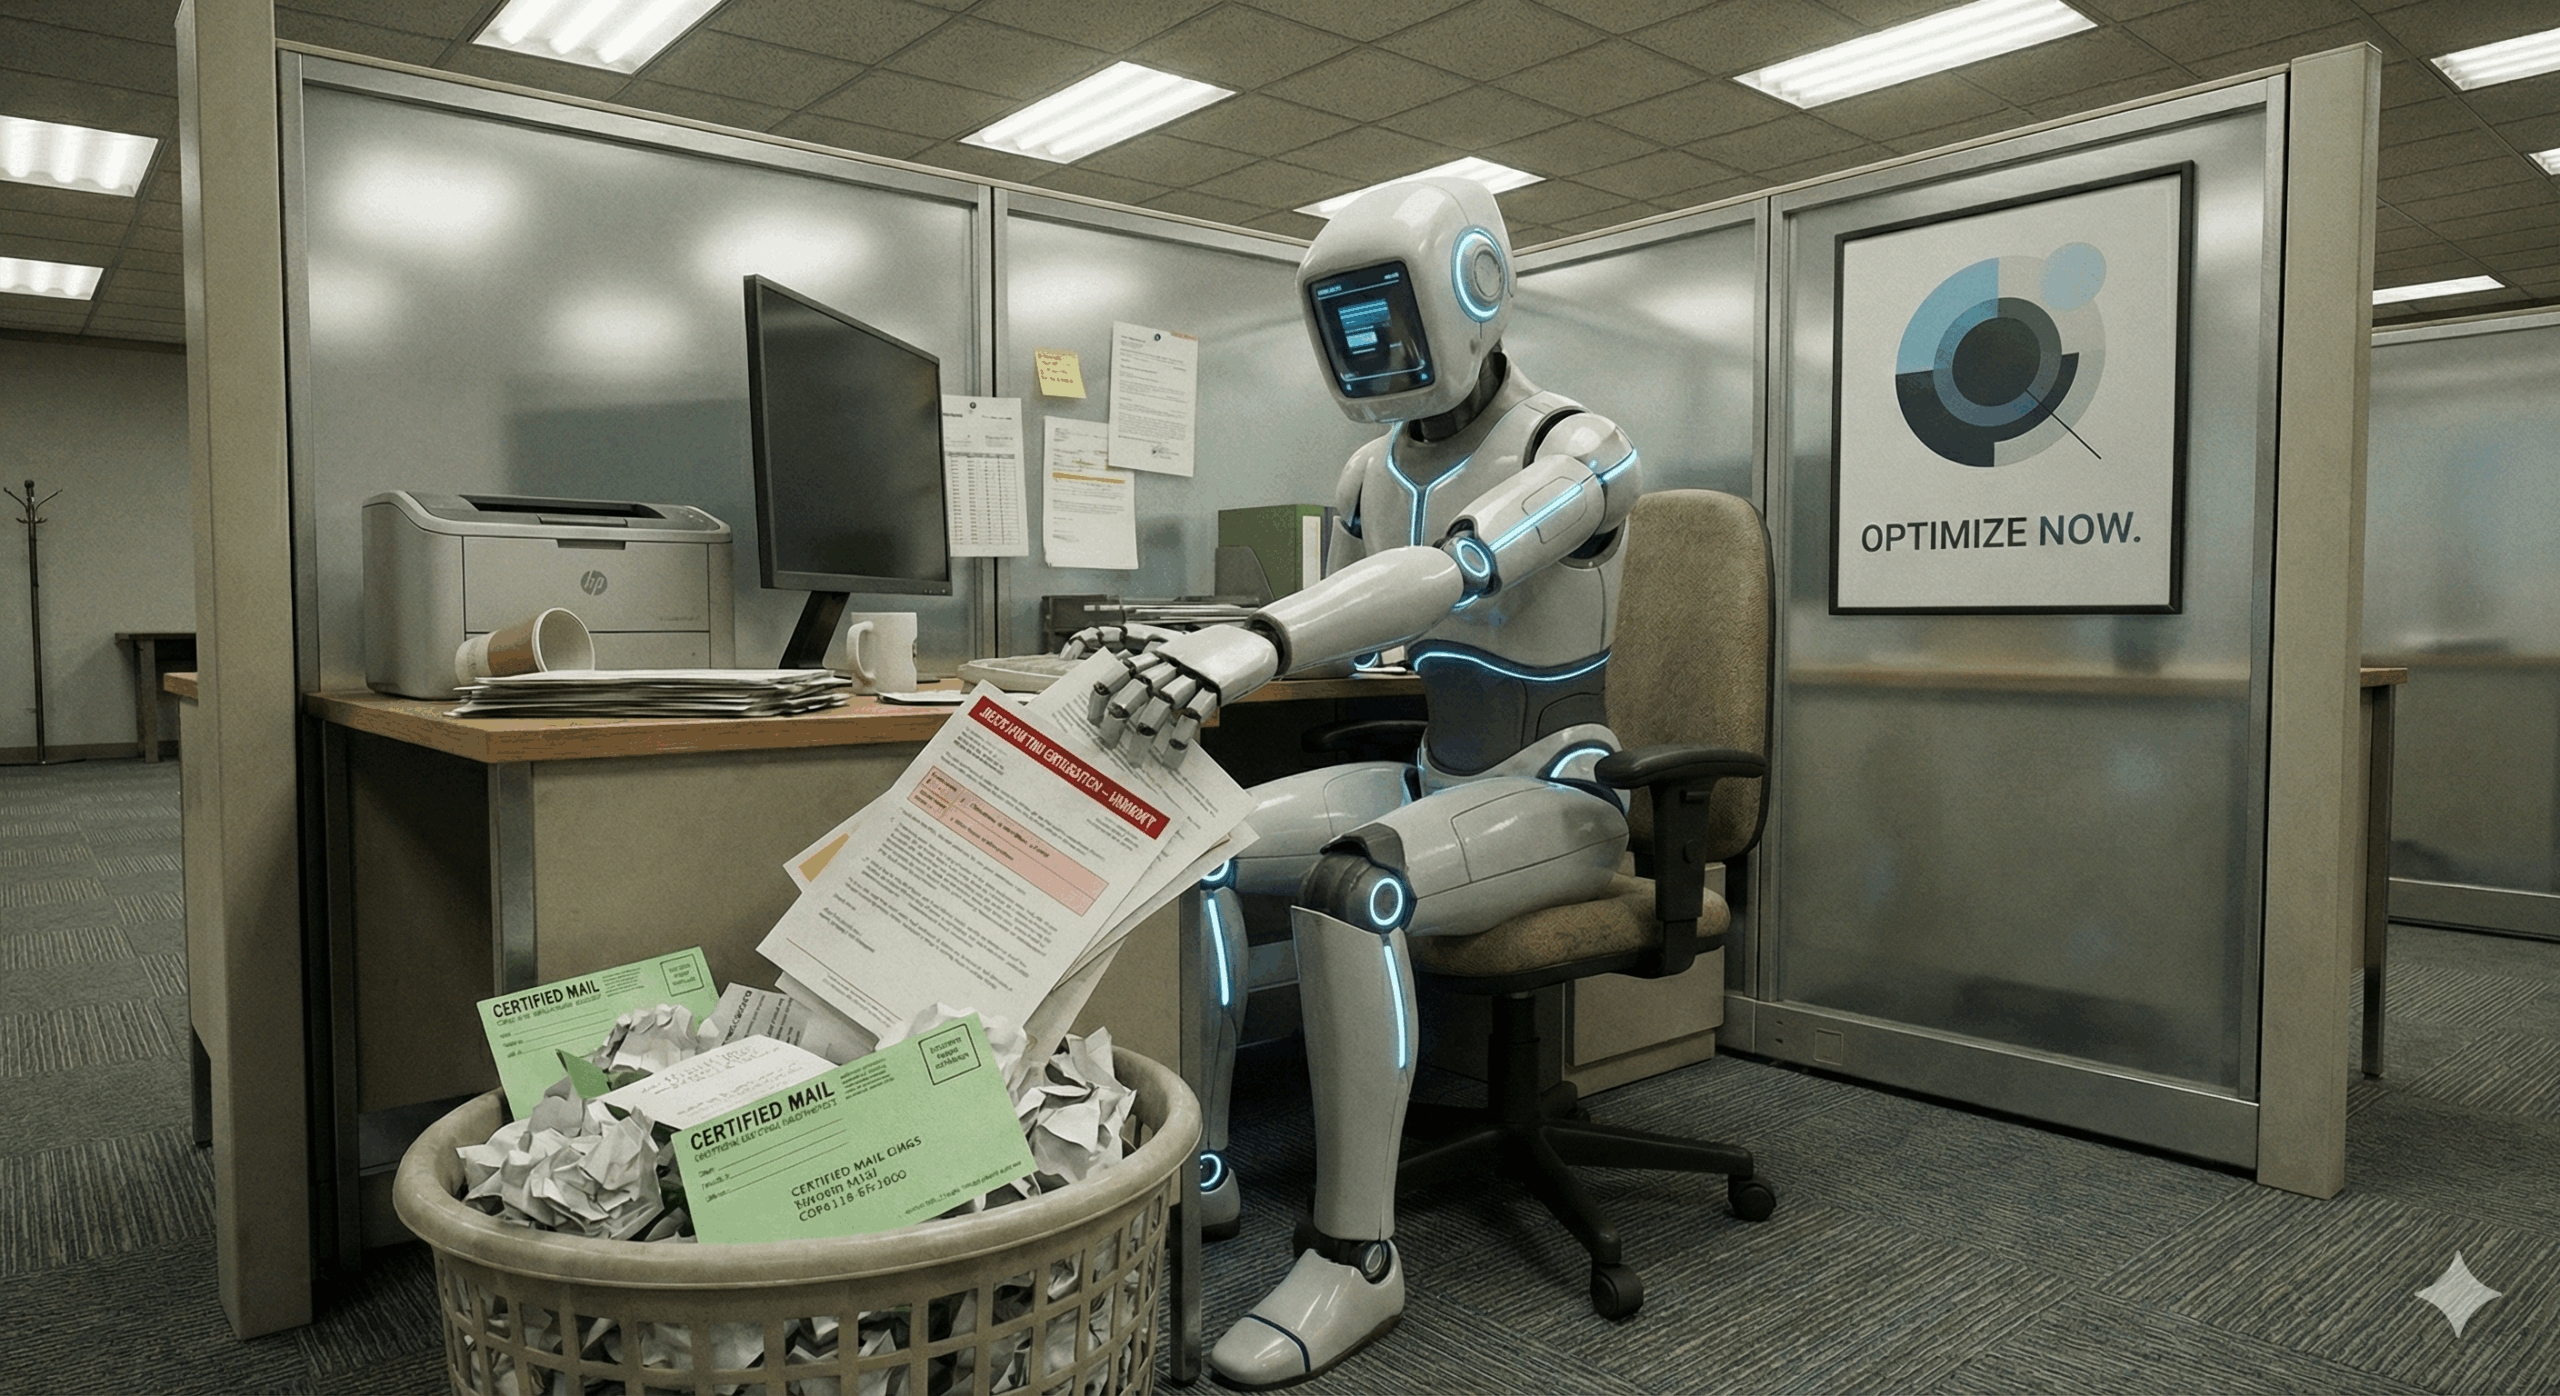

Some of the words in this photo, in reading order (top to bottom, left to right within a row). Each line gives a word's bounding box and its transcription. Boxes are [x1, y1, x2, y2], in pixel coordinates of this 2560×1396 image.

[1861, 516, 2028, 553] OPTIMIZE
[2039, 511, 2142, 546] NOW.
[582, 570, 606, 596] hp
[492, 988, 564, 1018] CERTIFIED
[566, 980, 600, 1003] MAIL
[690, 1101, 783, 1151] CERTIFIED
[787, 1080, 836, 1112] MAIL
[790, 1166, 851, 1198] CERTIFIED
[853, 1154, 886, 1172] MAIL
